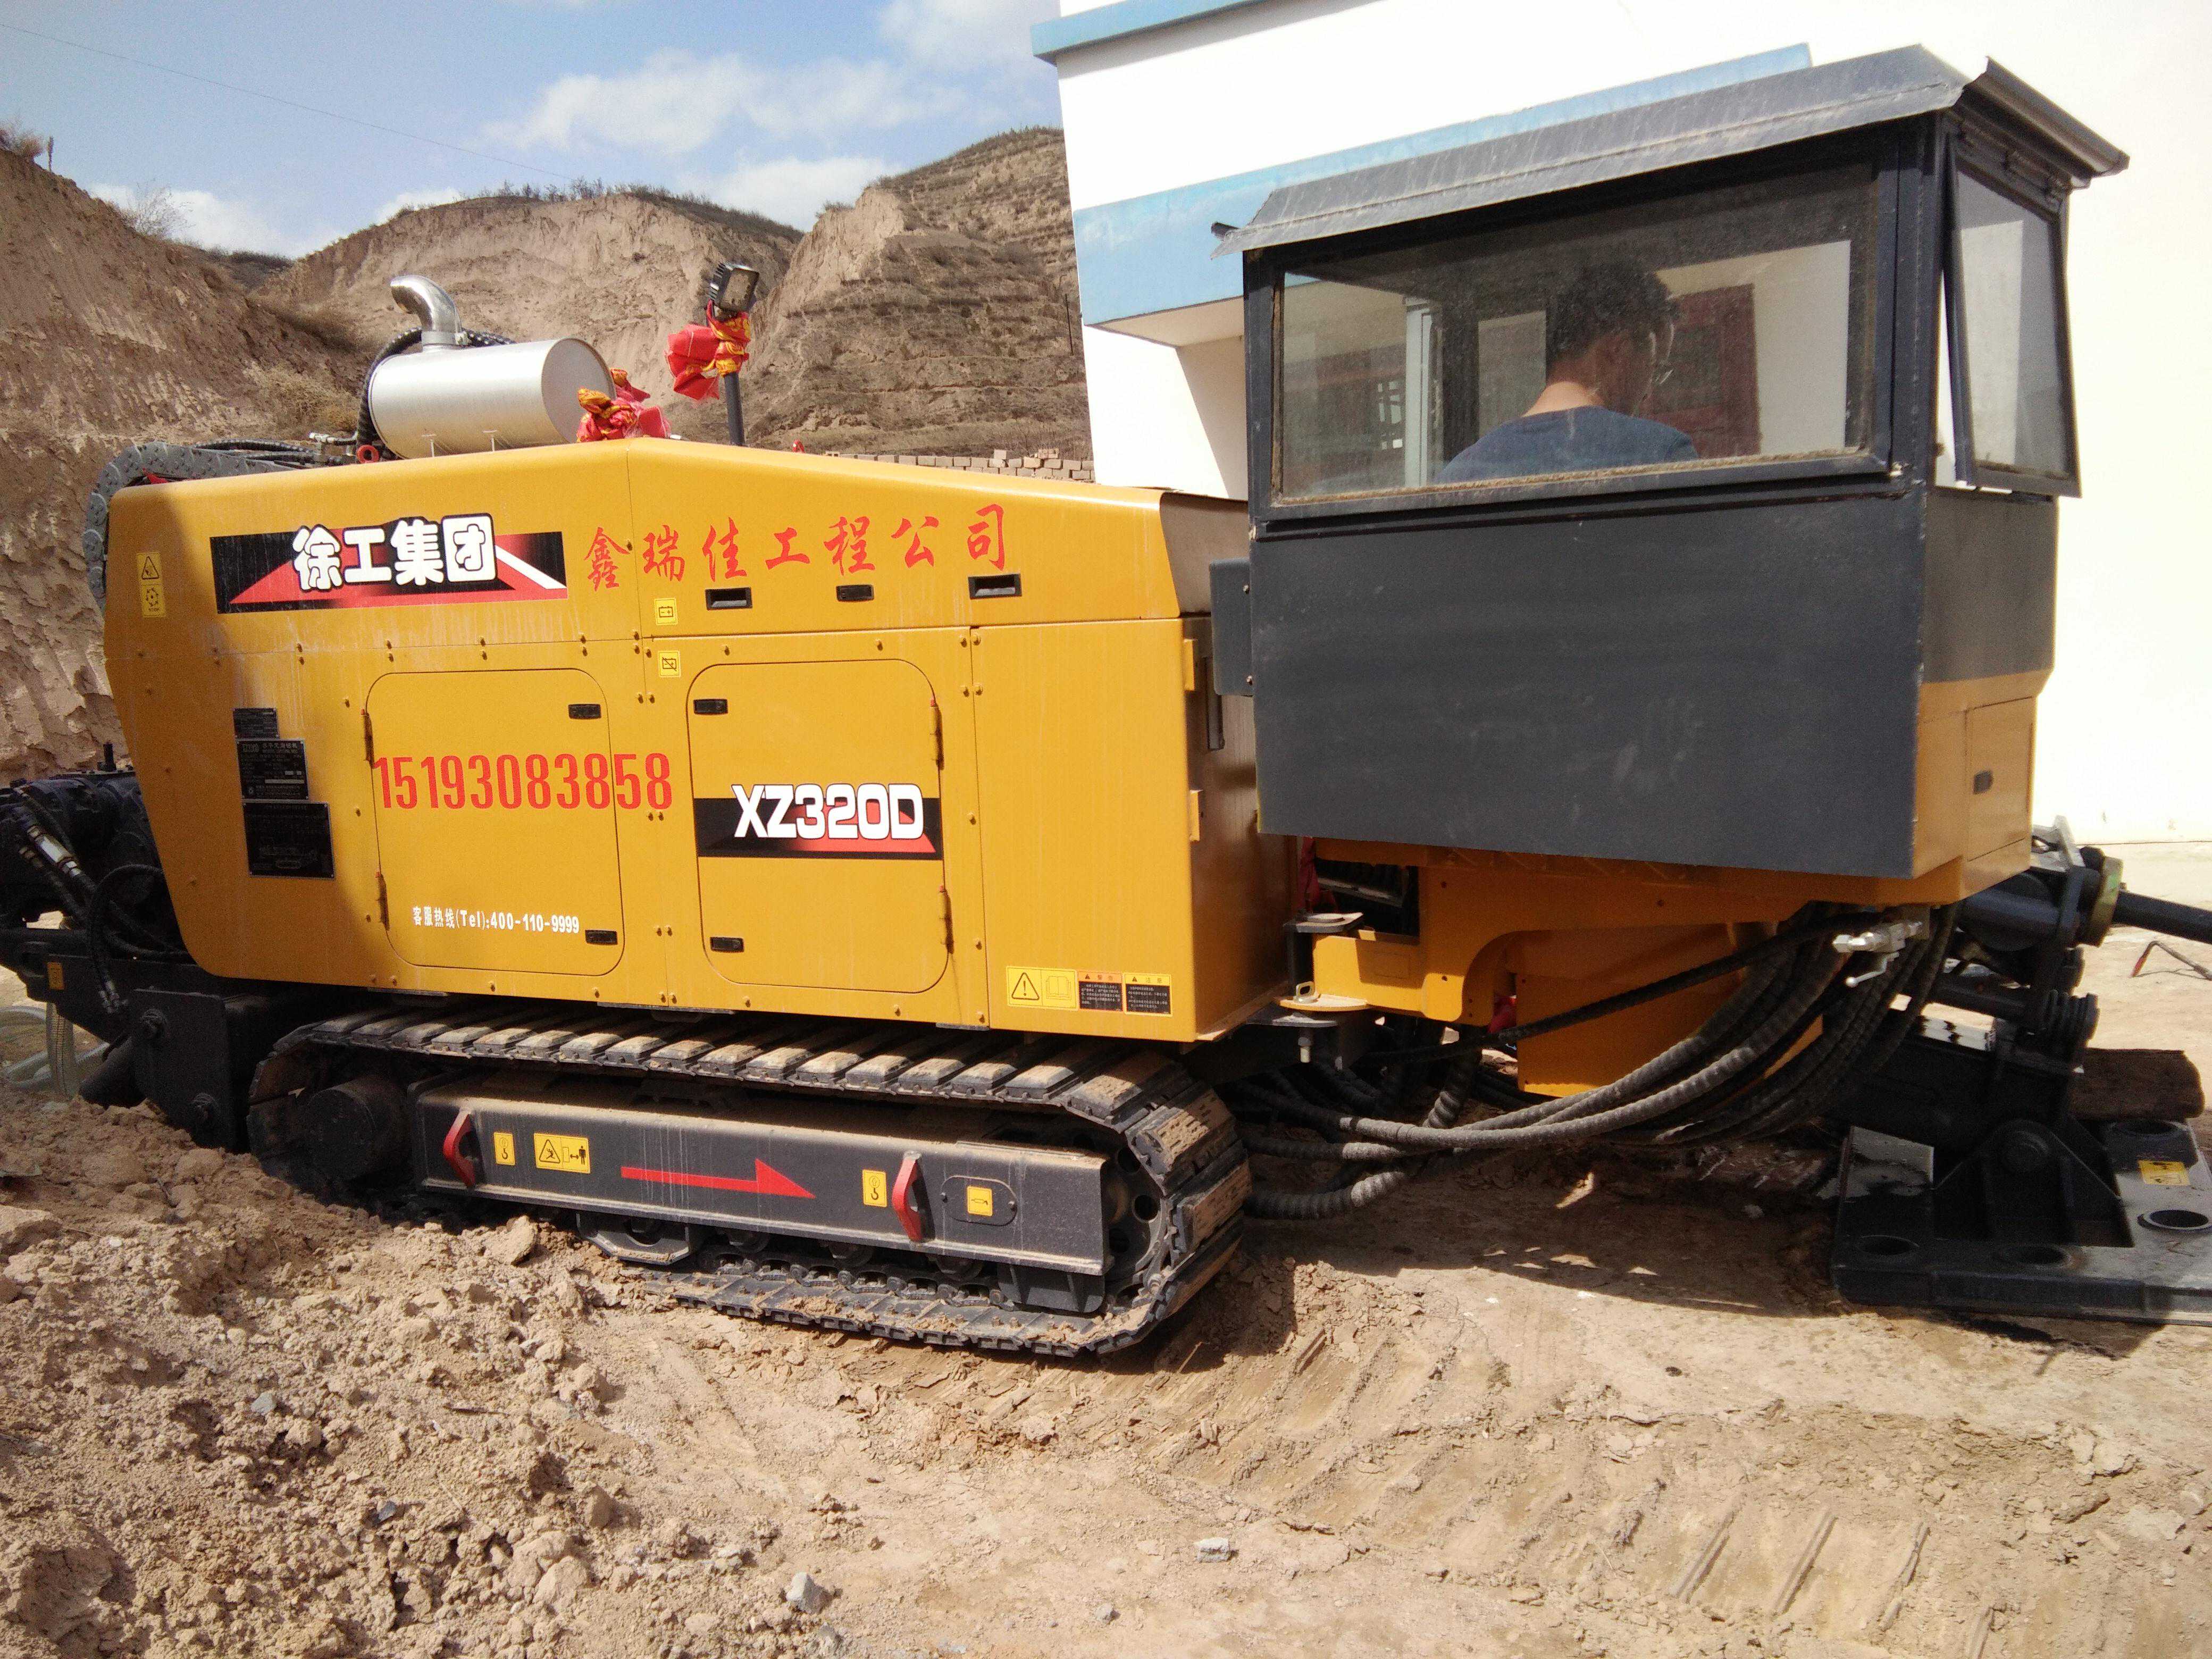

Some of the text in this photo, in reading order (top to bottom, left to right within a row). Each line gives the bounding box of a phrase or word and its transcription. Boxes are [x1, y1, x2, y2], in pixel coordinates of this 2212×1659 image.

[292, 514, 498, 591] 徐工集团
[584, 504, 1006, 591] 鑫瑞佳工程公司
[373, 752, 673, 810] 15193083858
[731, 783, 924, 840] XZ320D
[413, 906, 580, 934] 客服热线(Tel):400-110-9999
